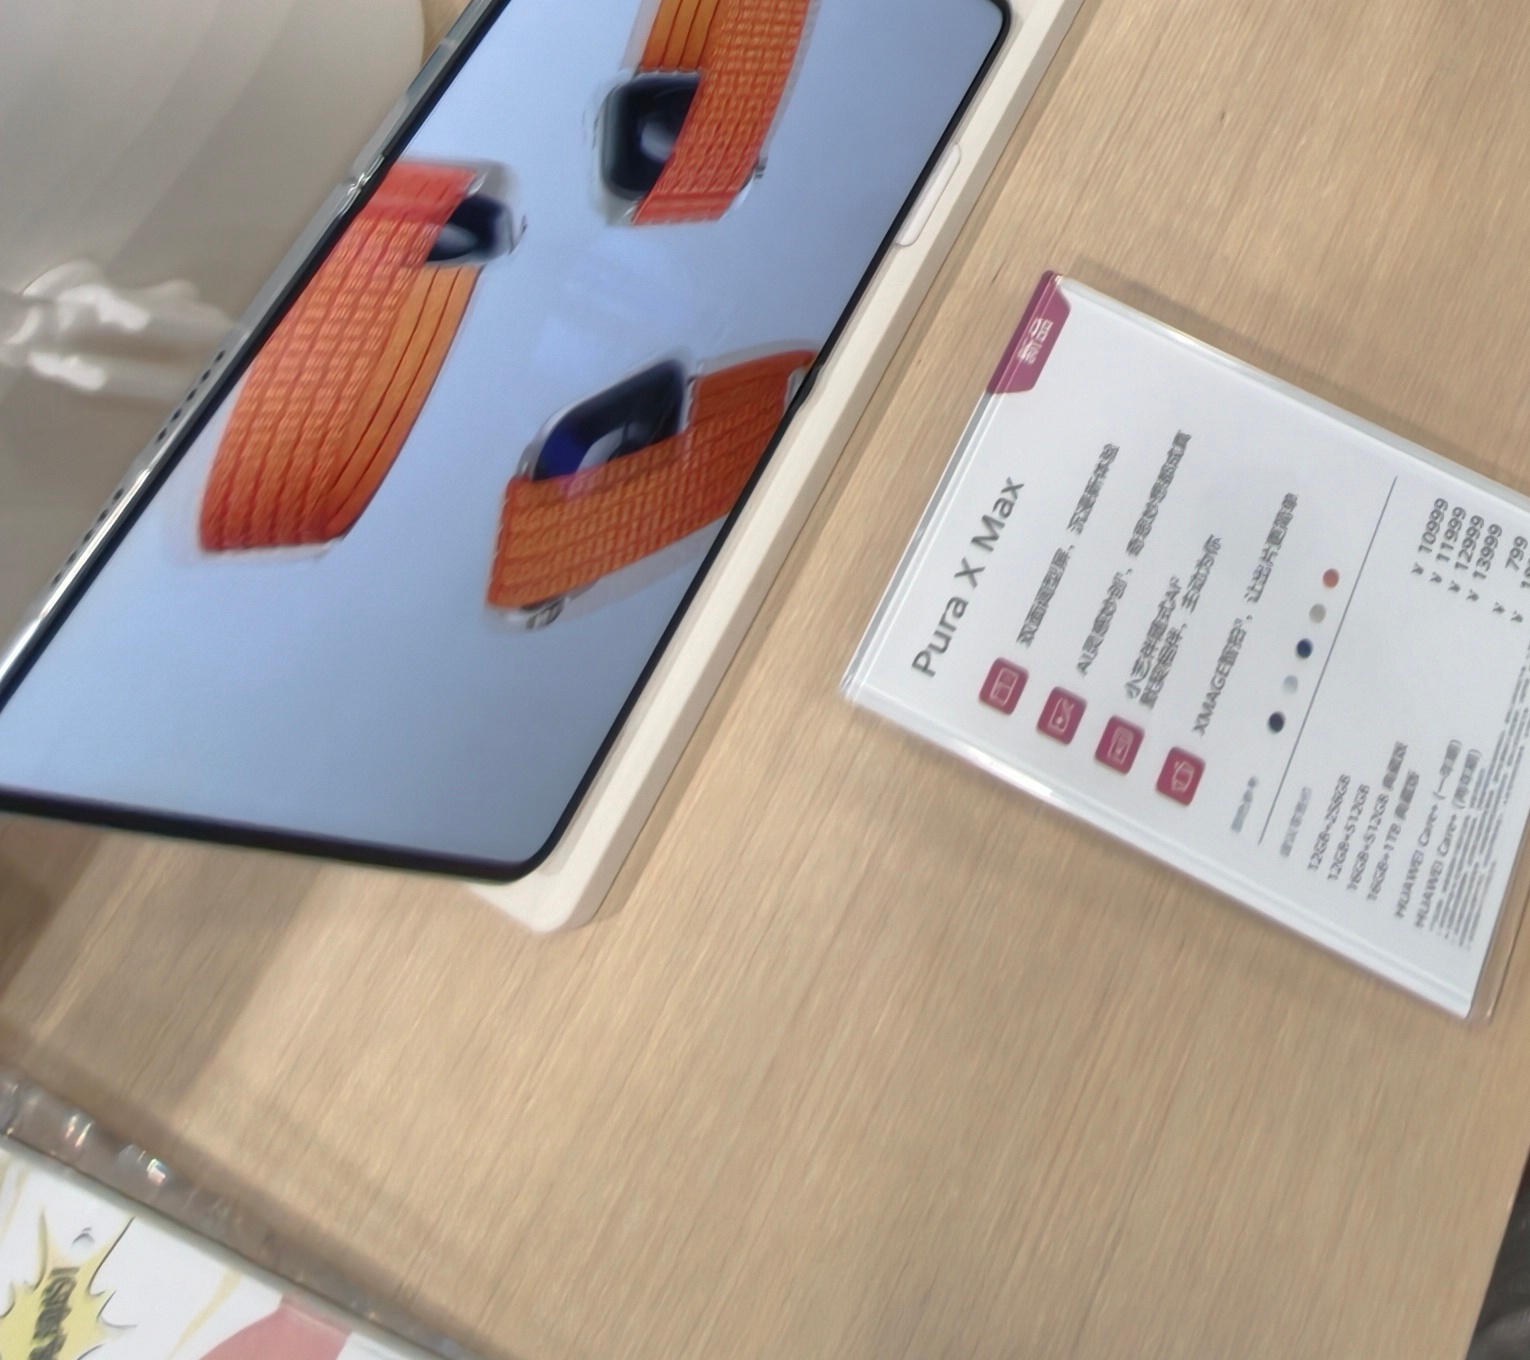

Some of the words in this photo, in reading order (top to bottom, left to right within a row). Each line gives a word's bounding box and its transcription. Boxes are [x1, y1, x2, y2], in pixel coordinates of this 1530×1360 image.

[911, 596, 968, 676] Pura
[954, 557, 984, 587] X
[971, 478, 1023, 551] Max
[1454, 515, 1484, 569] 12999
[1472, 523, 1502, 578] 13999
[1307, 774, 1350, 869] 12GB+256GB
[1417, 497, 1448, 552] 10999
[1327, 784, 1369, 879] 12GB+512GB
[1436, 506, 1466, 561] 11999
[1394, 849, 1423, 918] HUAWEI
[1504, 535, 1528, 570] 799
[1414, 860, 1442, 927] HUAWEI
